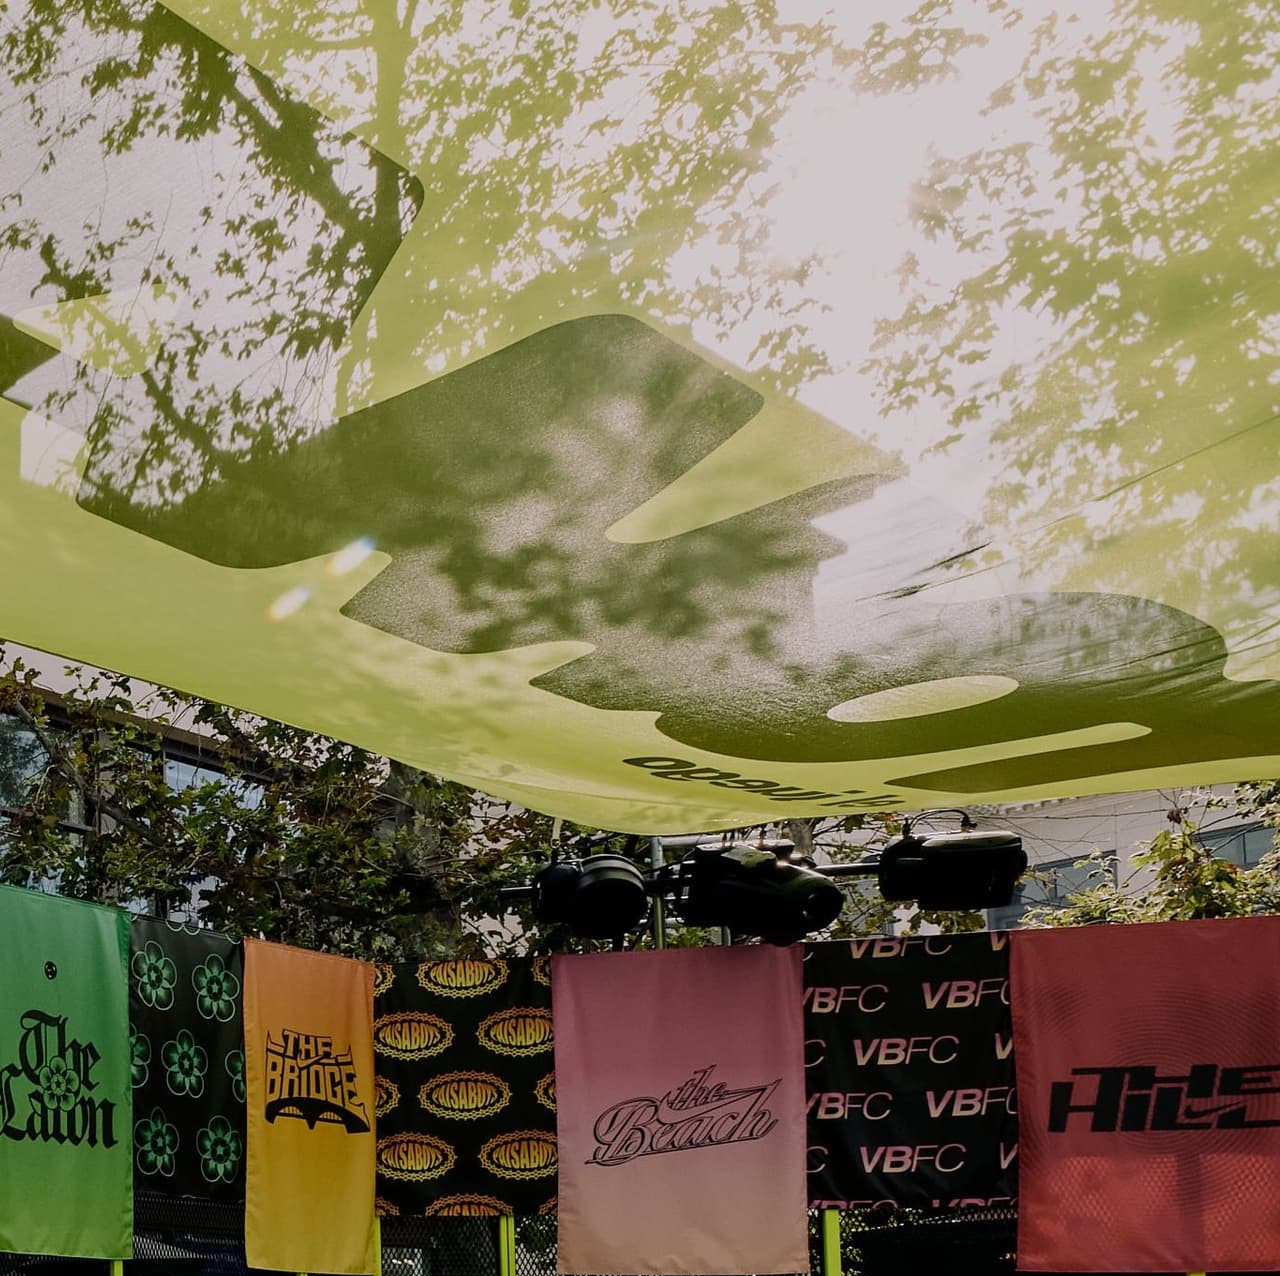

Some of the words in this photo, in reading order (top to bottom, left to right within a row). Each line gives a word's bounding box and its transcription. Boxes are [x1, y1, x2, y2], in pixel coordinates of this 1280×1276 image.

[849, 938, 952, 959] VBFC
[19, 1009, 101, 1090] The
[281, 1027, 334, 1060] THE
[378, 1021, 441, 1050] PAISABOYS
[853, 1035, 960, 1066] VBFC
[265, 1050, 366, 1109] BRIDGE
[431, 1081, 498, 1110] PAISABOYS
[677, 1064, 729, 1110] the
[1071, 1064, 1280, 1098] THE
[584, 1079, 782, 1166] Beach
[381, 1142, 443, 1171] PAISABOYS
[859, 1143, 966, 1174] VBFC
